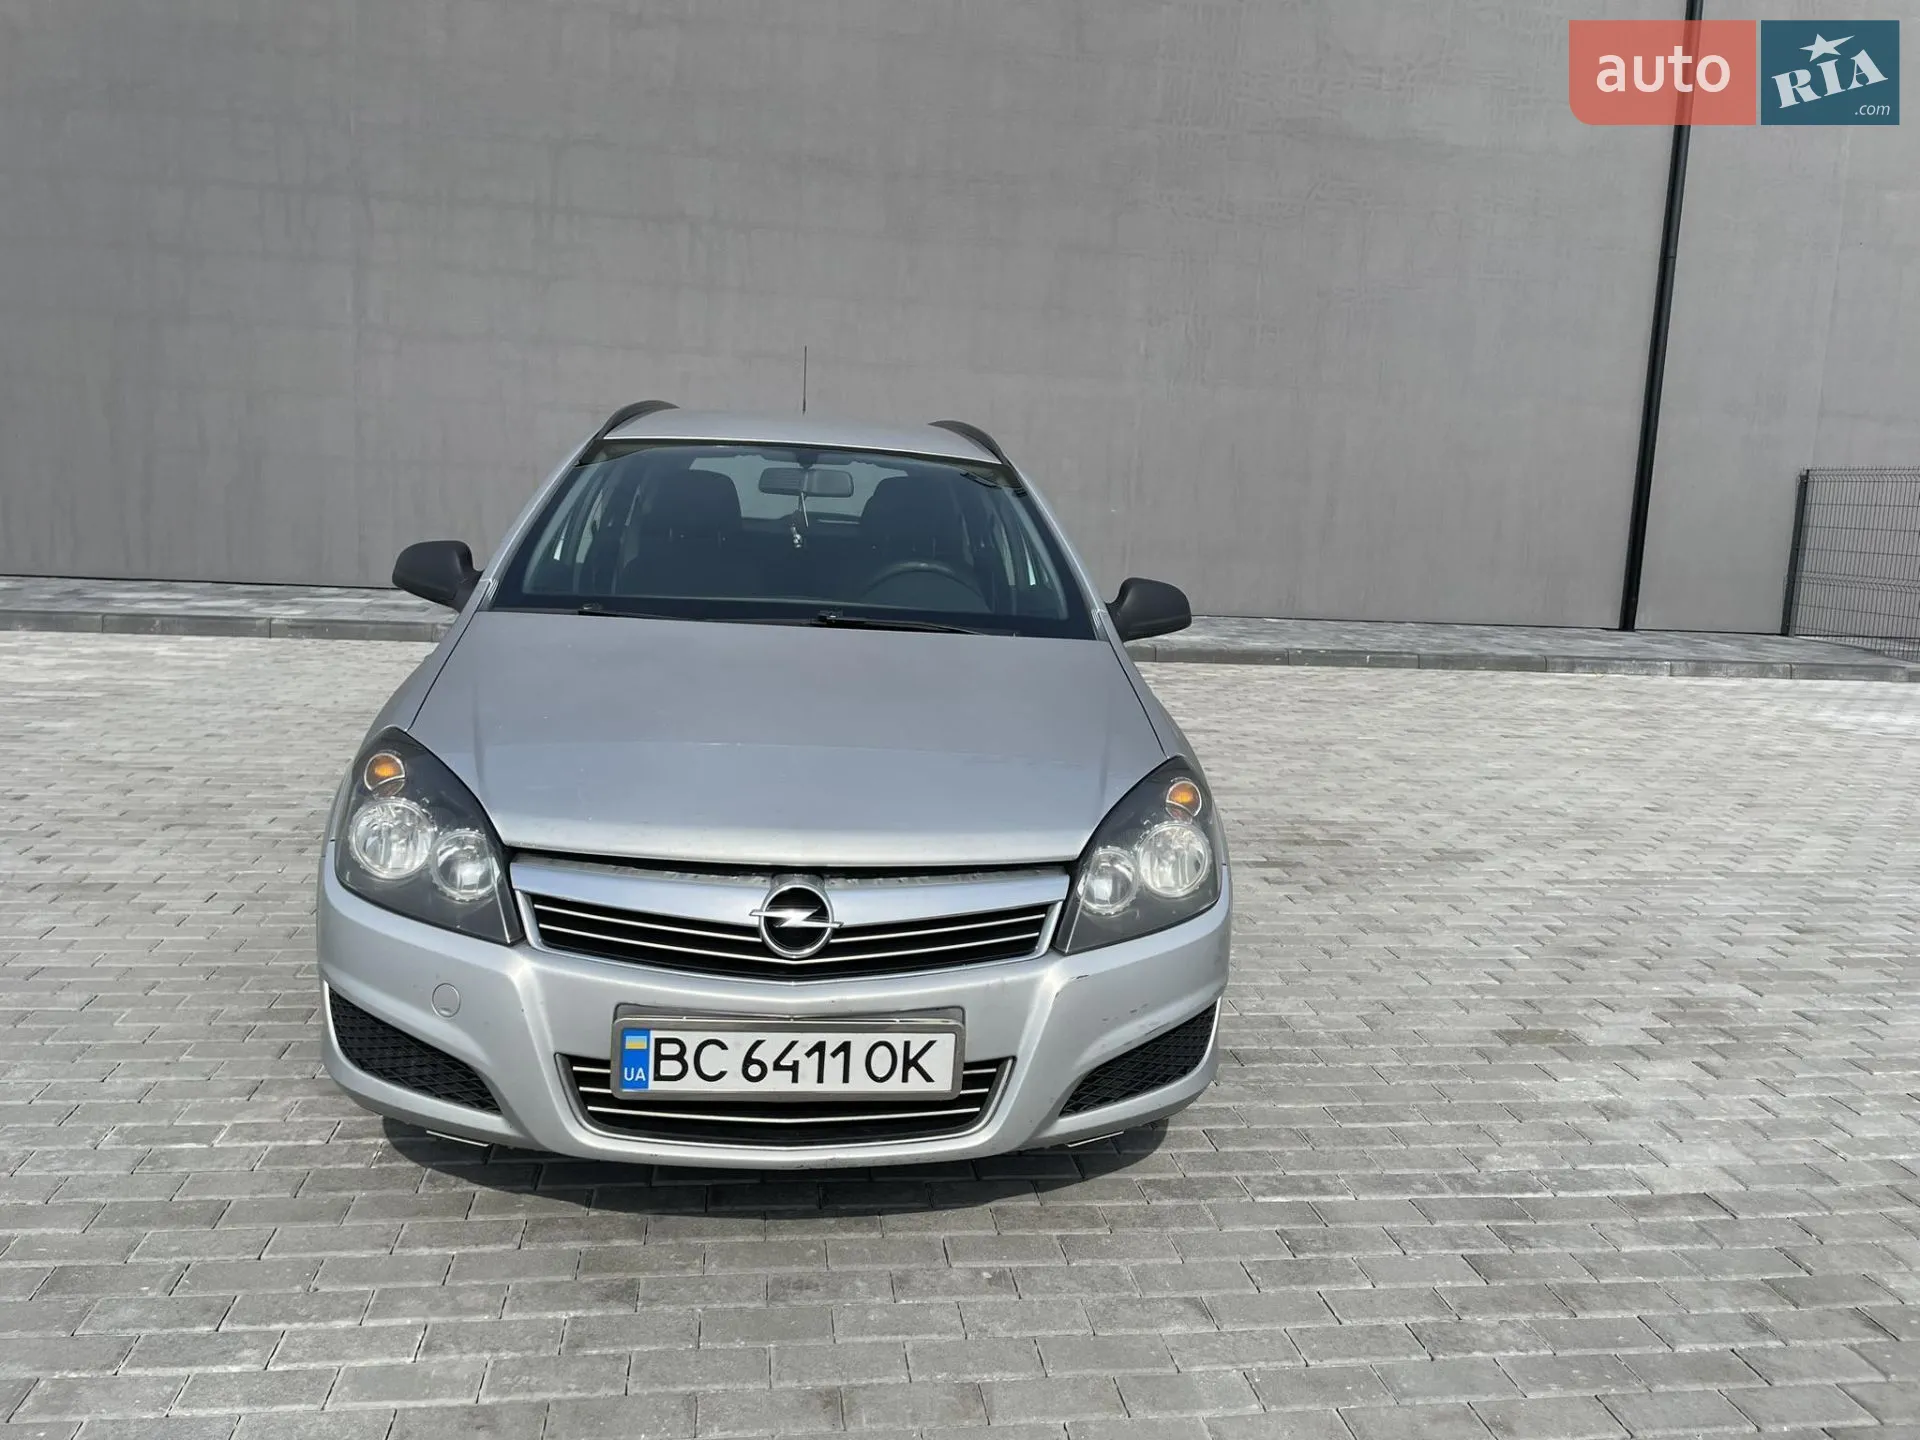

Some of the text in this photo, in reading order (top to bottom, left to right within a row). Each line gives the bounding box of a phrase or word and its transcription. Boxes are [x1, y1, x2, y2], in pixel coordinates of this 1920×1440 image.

[623, 1068, 646, 1082] UA
[653, 1037, 938, 1084] BC 6411 OK
